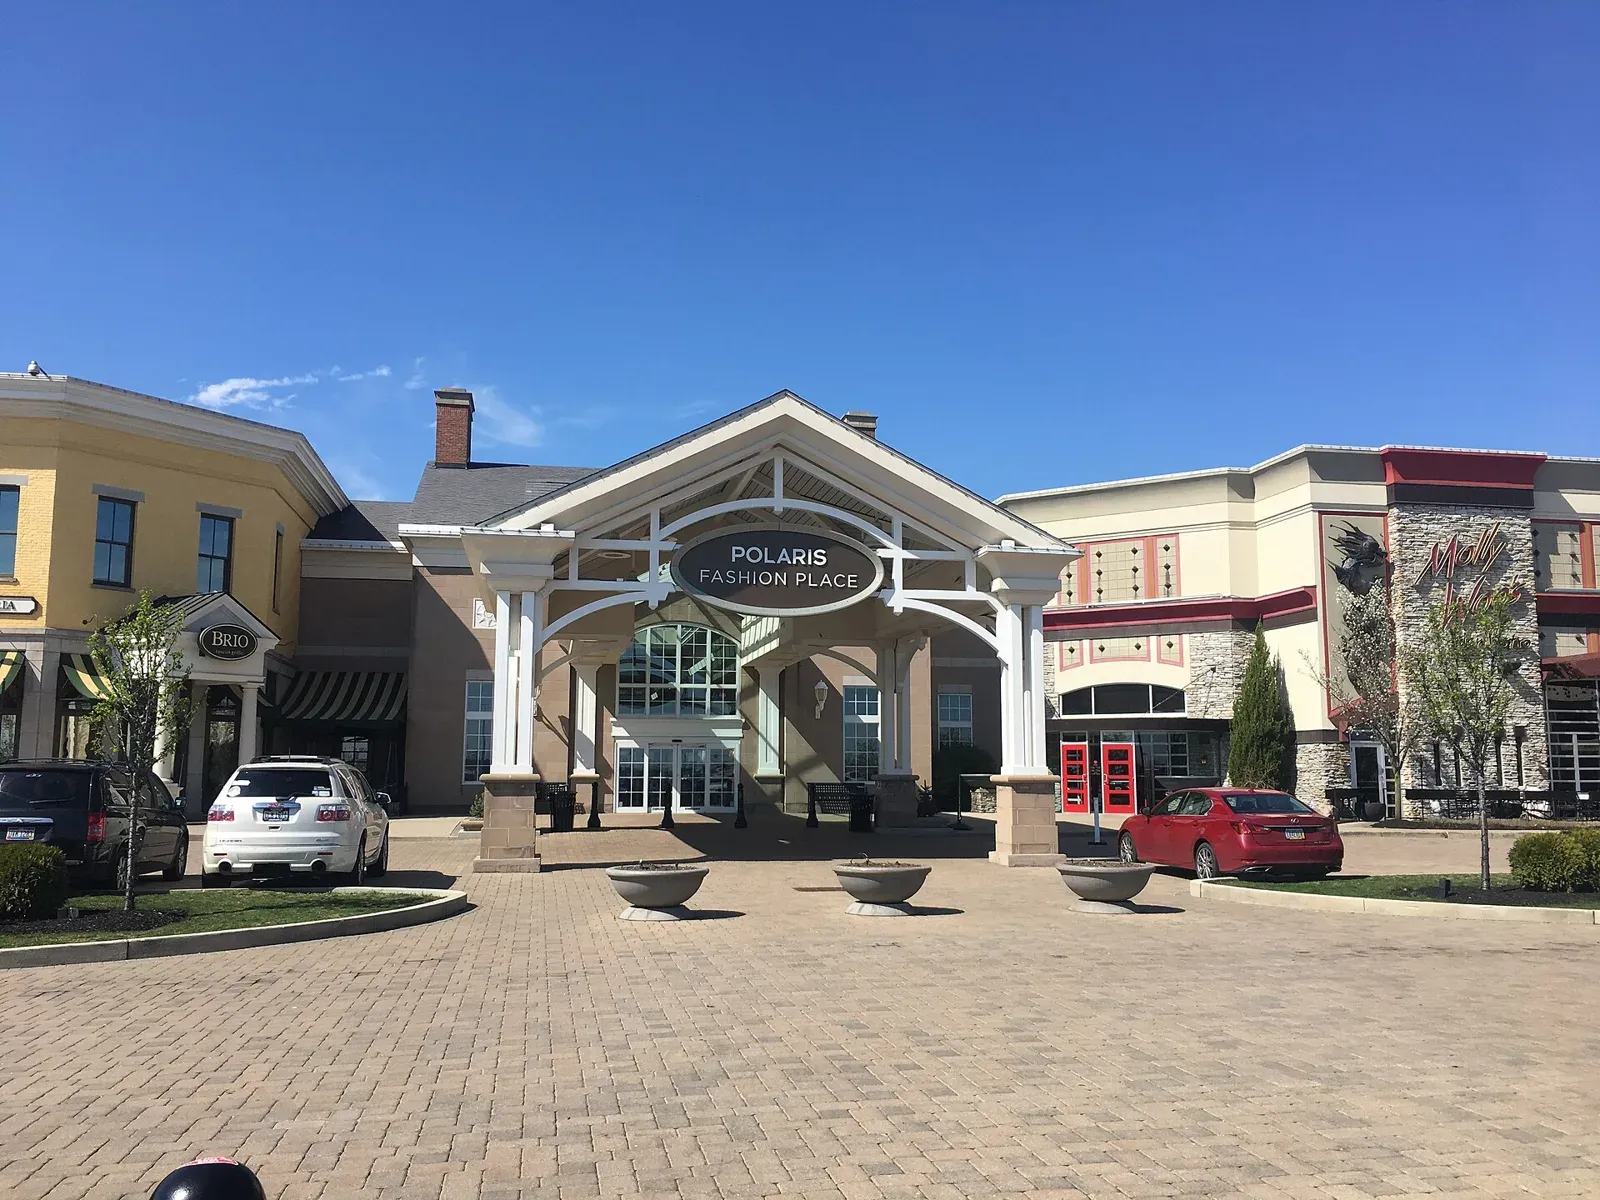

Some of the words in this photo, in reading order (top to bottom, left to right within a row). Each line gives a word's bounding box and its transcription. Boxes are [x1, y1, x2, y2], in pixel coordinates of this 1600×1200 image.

[731, 546, 828, 566] POLARIS
[1414, 521, 1506, 584] Molly
[699, 569, 787, 586] FASHION
[795, 572, 858, 588] PLACE
[0, 600, 17, 611] IA
